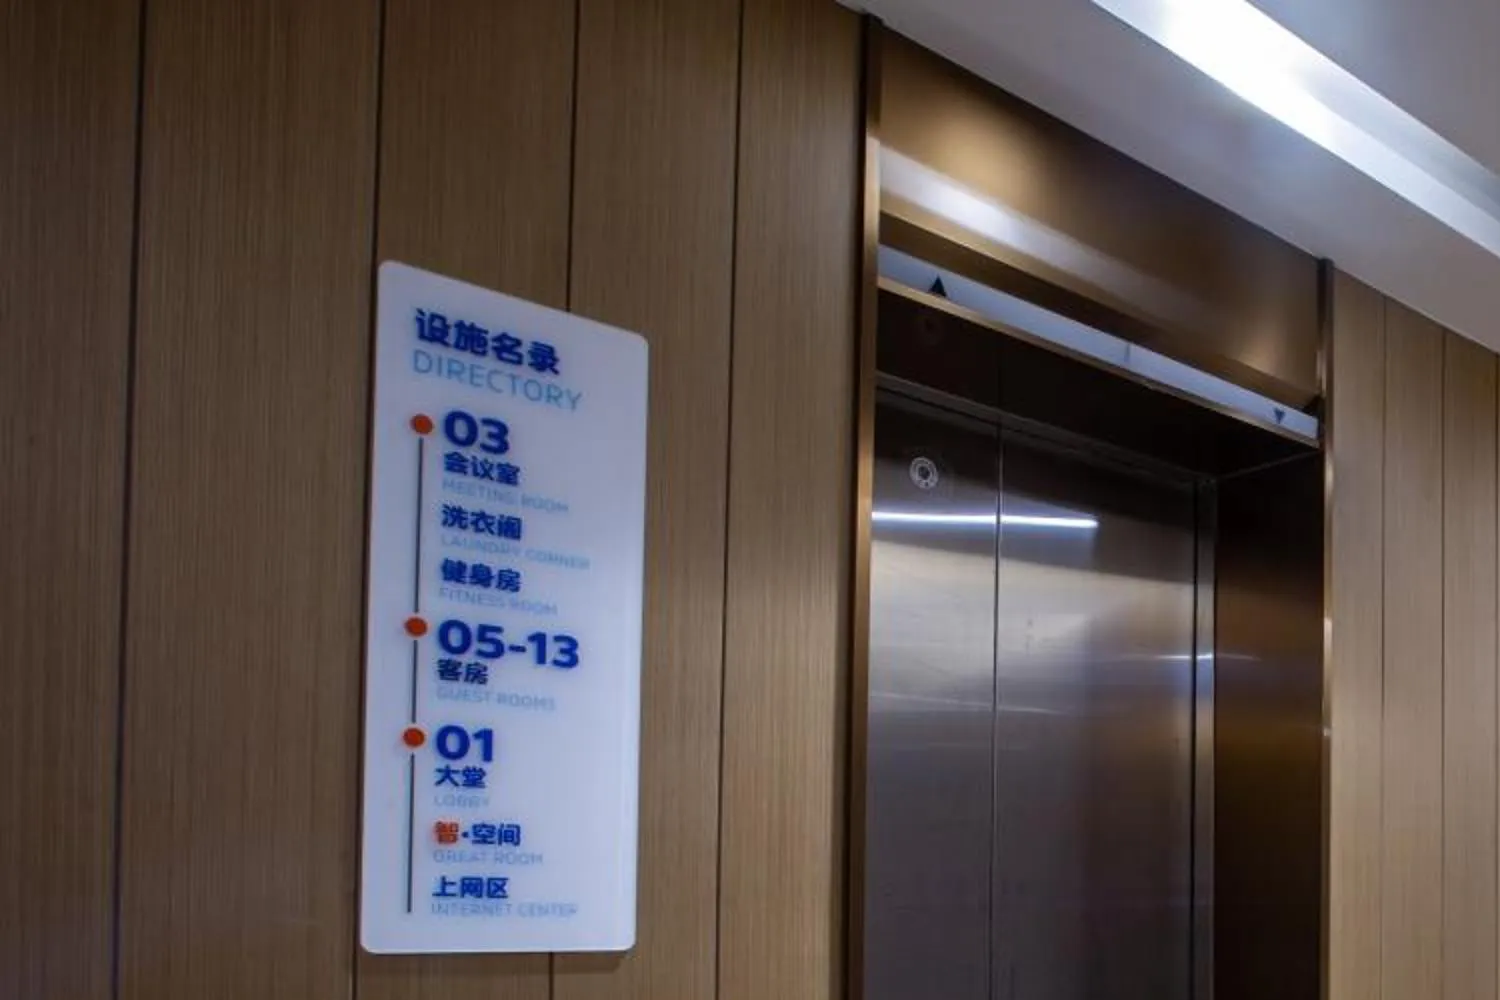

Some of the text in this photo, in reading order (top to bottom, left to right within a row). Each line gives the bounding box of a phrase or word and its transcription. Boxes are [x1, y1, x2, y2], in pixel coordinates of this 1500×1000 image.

[416, 308, 560, 375] 设施名录
[412, 350, 582, 411] DIRECTORY
[444, 411, 510, 454] 03
[444, 453, 520, 486] 会议室
[441, 558, 520, 592] 健身房
[438, 619, 579, 668] 05-13
[438, 659, 488, 685] 客房
[436, 725, 494, 762] 01
[435, 765, 486, 788] 大堂
[432, 875, 509, 899] 上网区
